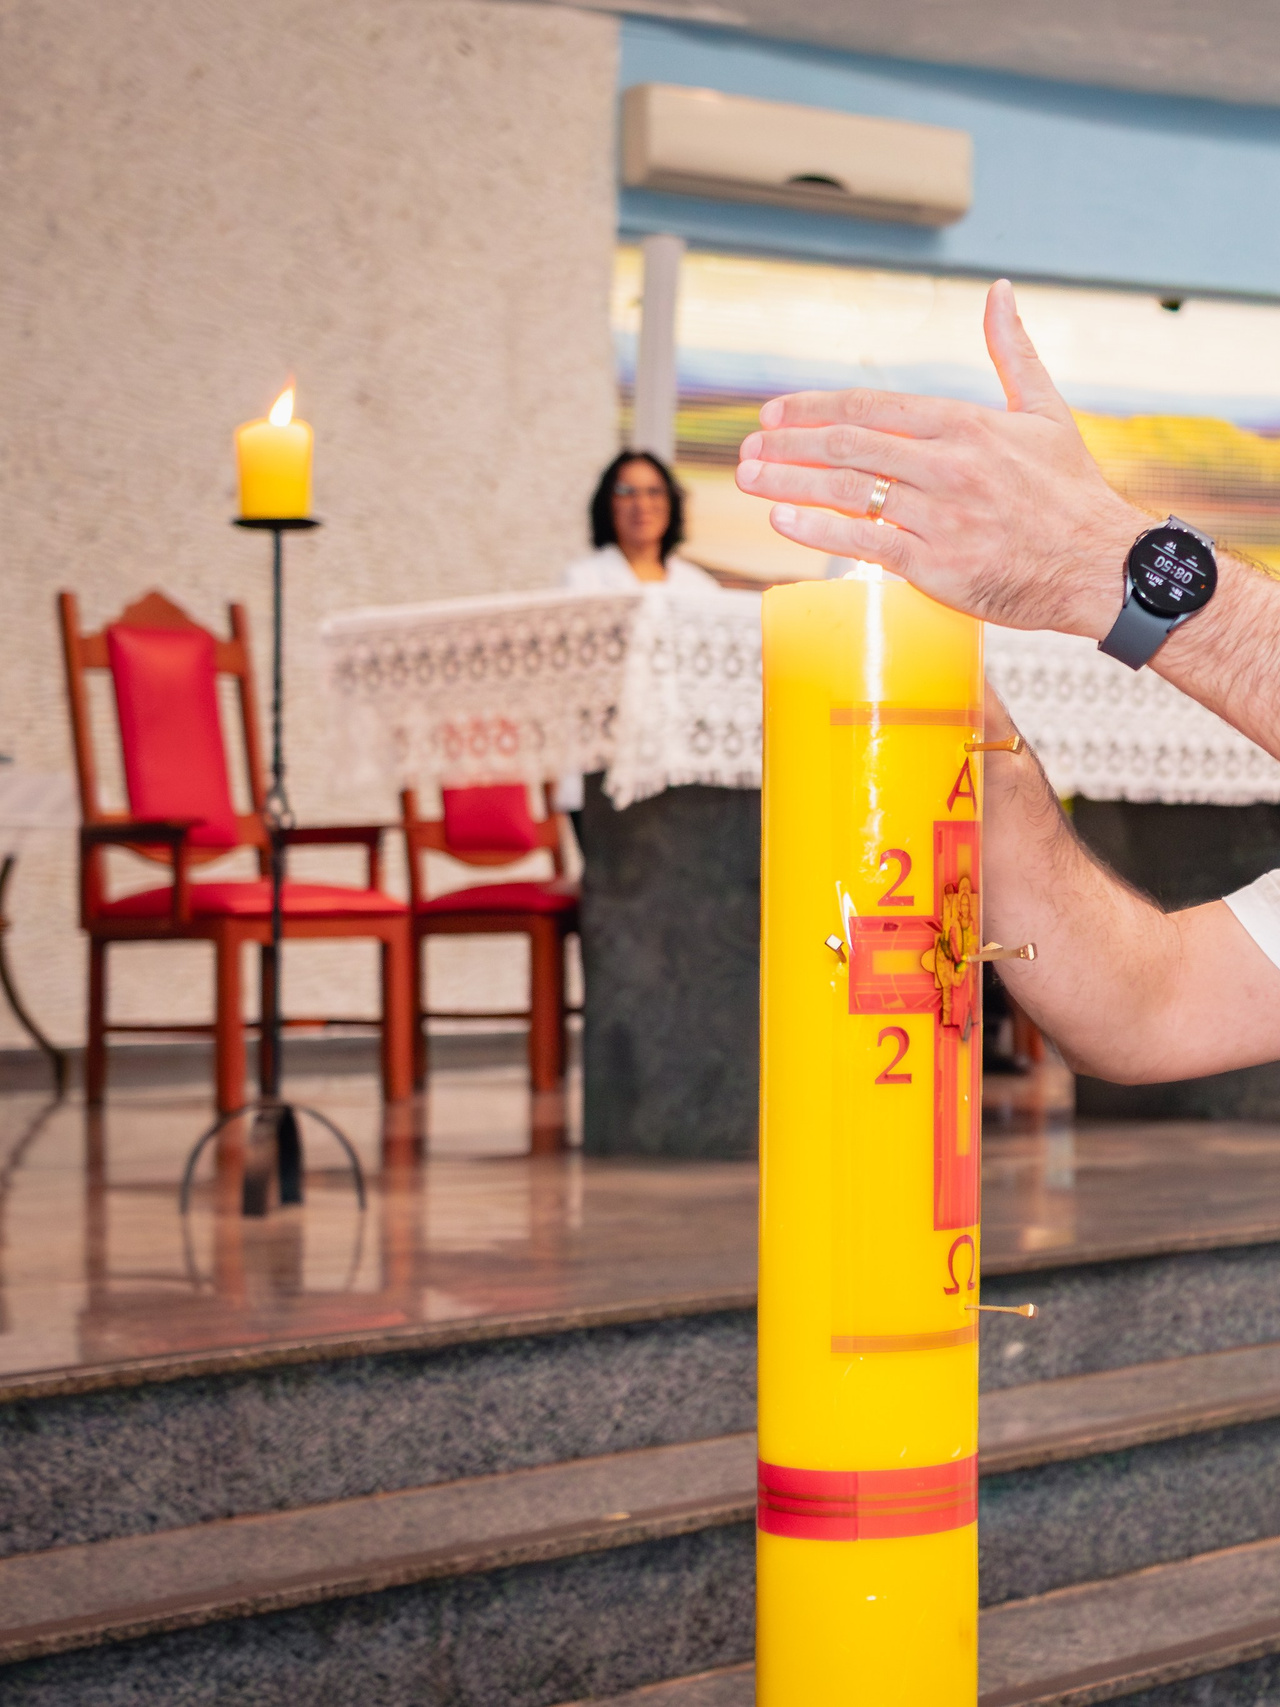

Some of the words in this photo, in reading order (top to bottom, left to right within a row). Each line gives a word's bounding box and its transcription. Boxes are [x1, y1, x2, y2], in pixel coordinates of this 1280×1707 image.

[1153, 555, 1193, 584] 08:50
[946, 756, 977, 812] A
[877, 848, 915, 907] 2
[874, 1026, 912, 1085] 2
[943, 1234, 976, 1296] Ω
